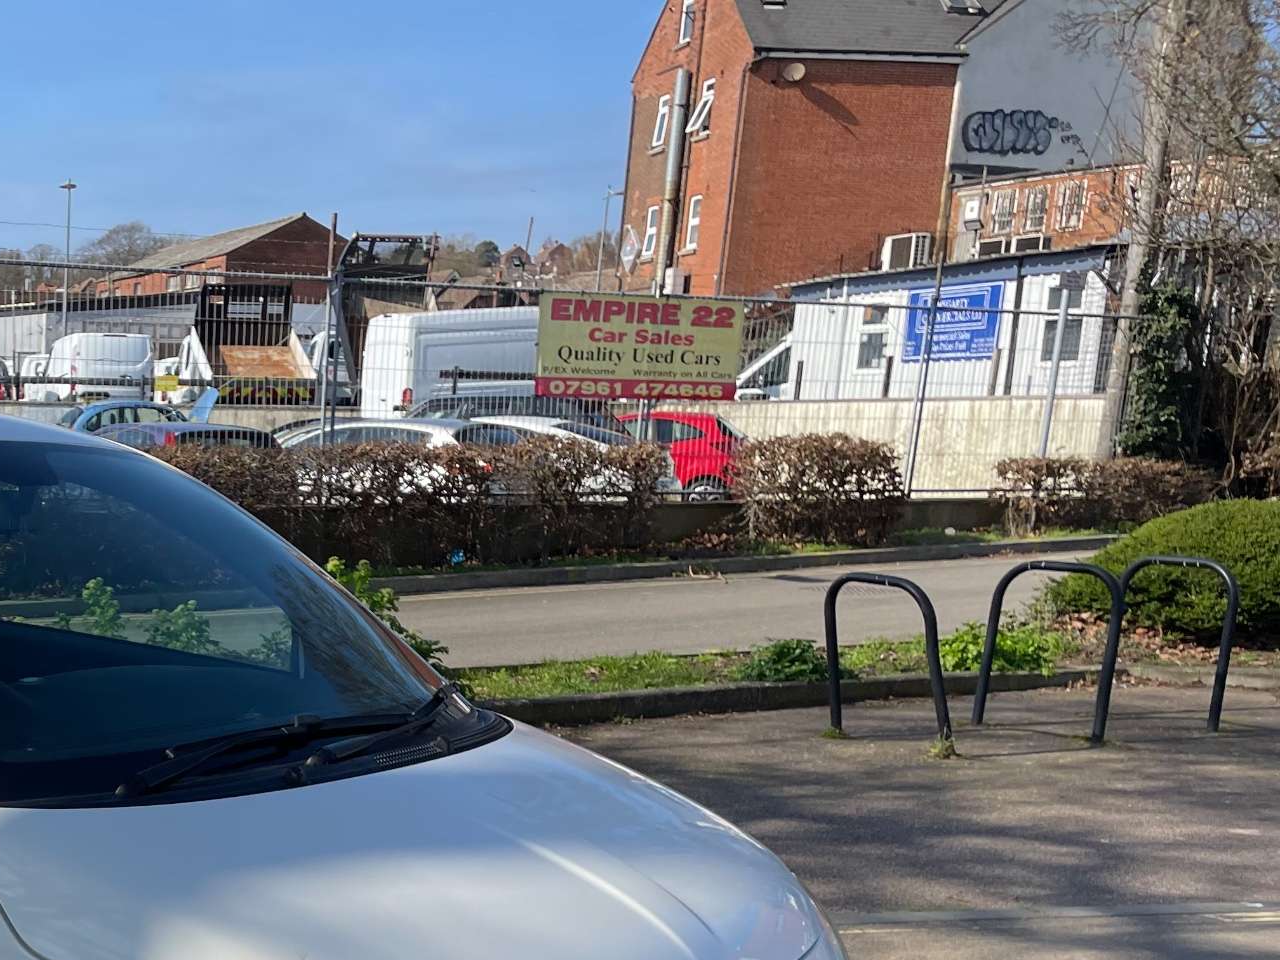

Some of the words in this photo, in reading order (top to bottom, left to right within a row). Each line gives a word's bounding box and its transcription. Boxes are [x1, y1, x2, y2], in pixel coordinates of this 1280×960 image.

[550, 298, 682, 326] EMPIRE
[690, 305, 736, 329] 22
[588, 327, 628, 344] Car
[634, 329, 695, 347] Sales
[558, 345, 625, 367] Quality
[632, 347, 674, 365] Used
[680, 350, 721, 366] Cars
[571, 367, 616, 376] Welcome
[633, 368, 678, 379] Warranty
[681, 370, 693, 378] on
[695, 369, 708, 378] All
[710, 370, 733, 379] Cars
[549, 379, 624, 397] 07961
[633, 382, 724, 398] 474646
